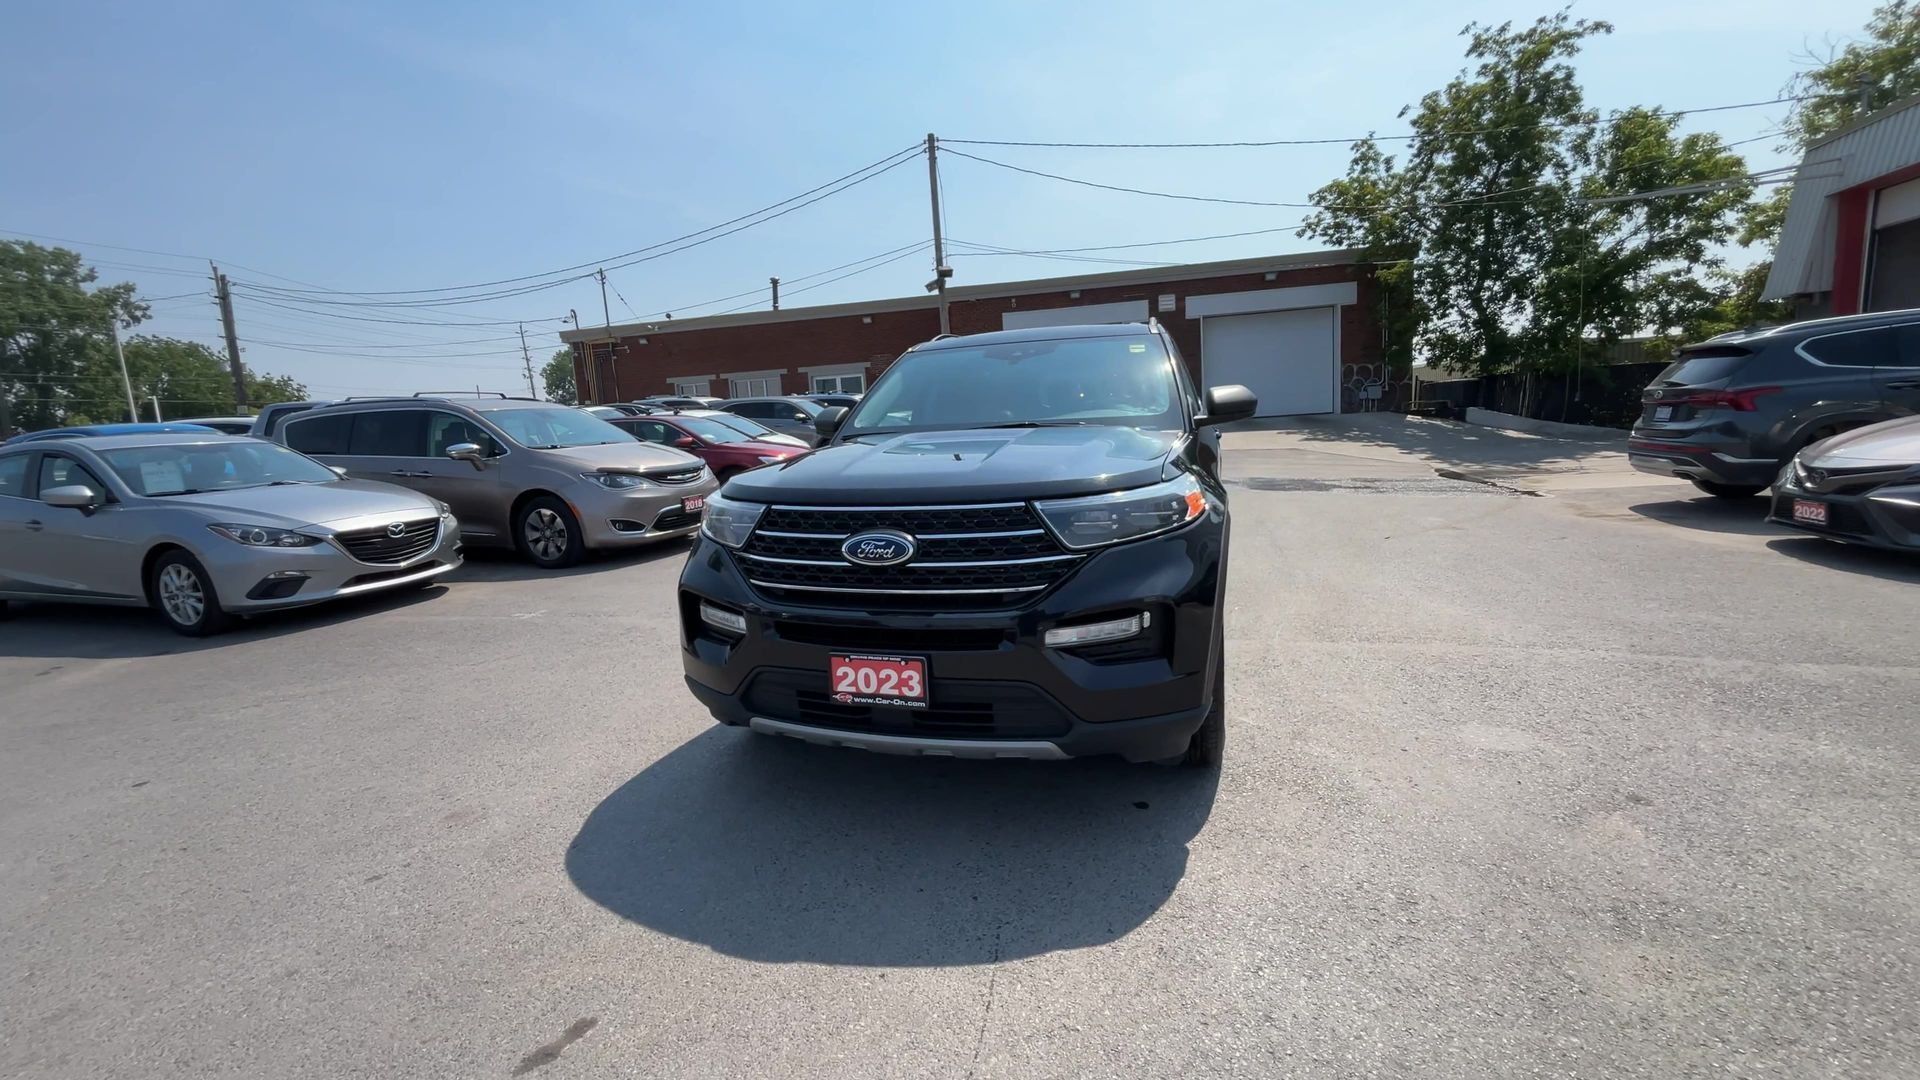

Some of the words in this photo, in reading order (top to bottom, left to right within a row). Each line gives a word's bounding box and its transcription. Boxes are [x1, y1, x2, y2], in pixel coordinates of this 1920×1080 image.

[685, 499, 703, 510] 2018
[1795, 505, 1825, 521] 2022
[857, 540, 895, 558] Ford
[836, 666, 921, 697] 2023
[853, 696, 926, 707] www.Car-On.com
